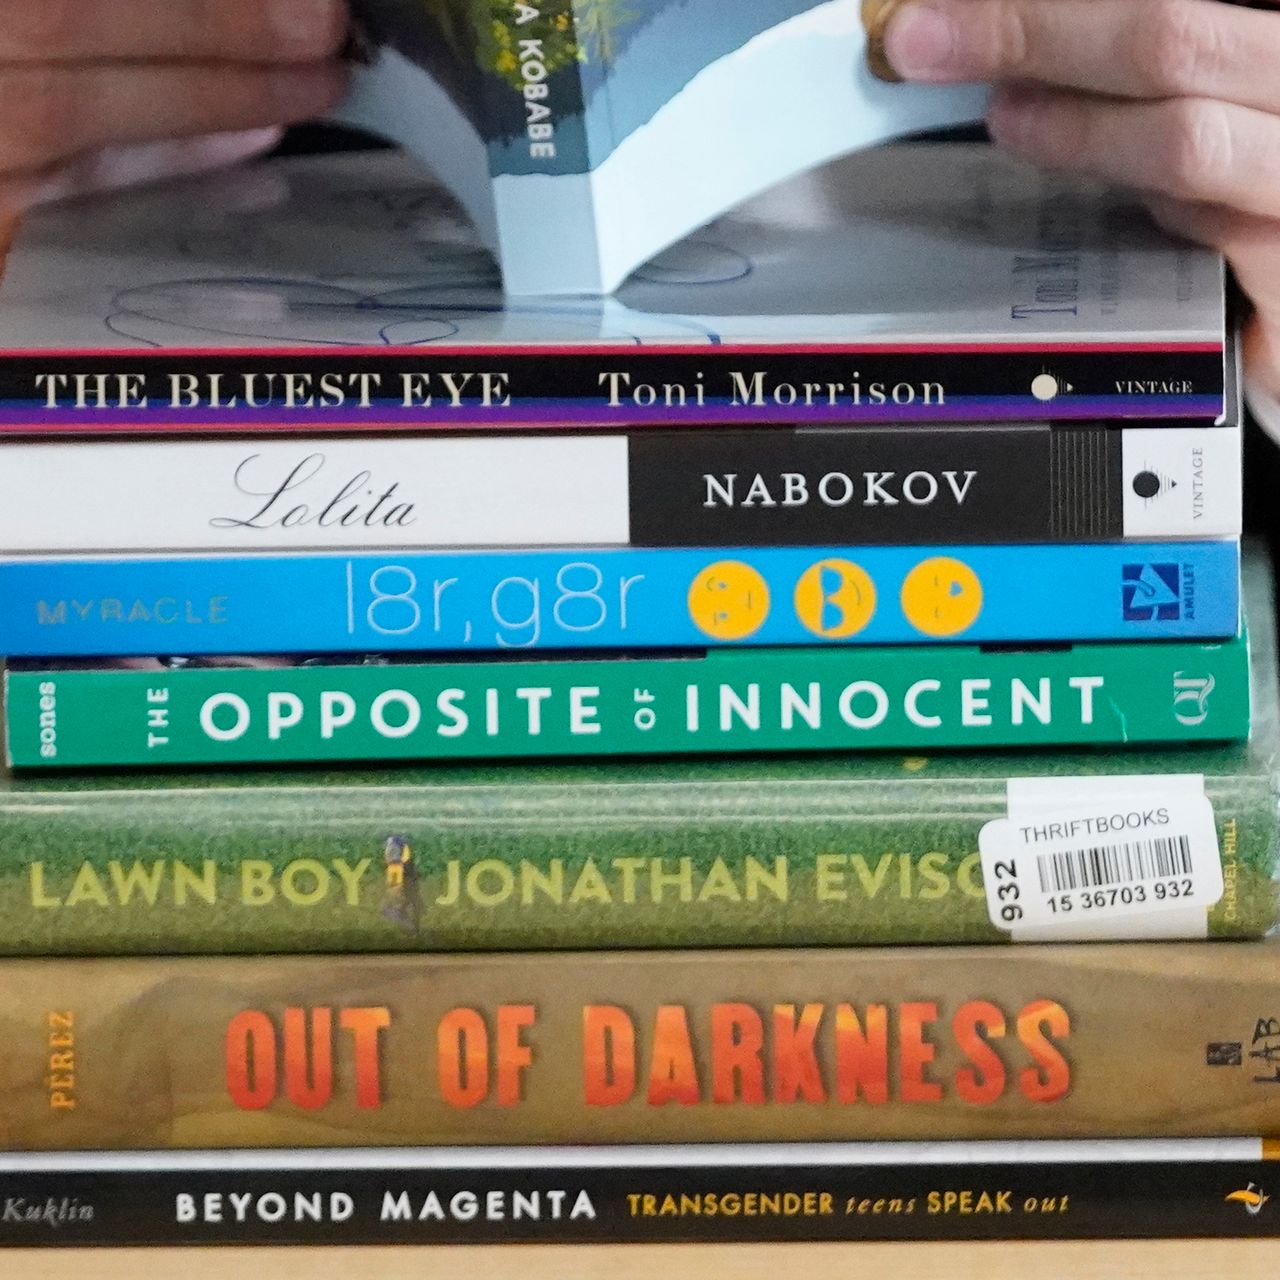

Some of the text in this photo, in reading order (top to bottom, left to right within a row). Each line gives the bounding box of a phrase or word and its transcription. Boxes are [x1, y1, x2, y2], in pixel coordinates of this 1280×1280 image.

[518, 39, 557, 159] KOBABE
[35, 370, 1193, 409] THE BLUEST EYE Toni Morrison VINTAGE
[208, 452, 978, 532] Lolita NABOKOV
[1191, 447, 1204, 519] VINTAGE
[36, 595, 229, 625] MYRACLE
[1183, 563, 1195, 620] AMULET
[39, 681, 57, 757] sones
[147, 676, 1104, 748] THE OPPOSITE OF INNOCENT
[1020, 808, 1170, 844] THRIFTBOOKS
[30, 859, 216, 908] LAWN
[241, 857, 371, 907] BOY
[434, 855, 789, 907] JONATHAN
[994, 858, 1023, 921] 932
[1047, 879, 1194, 913] 15 36703 932
[1223, 818, 1237, 920] CHAPEL HILL
[226, 999, 1072, 1110] OUT OF DARKNESS
[2, 1196, 95, 1228] Kuklin
[176, 1190, 1070, 1222] BEYOND MAGENTA TRANSGENDER teens SPEAK out
